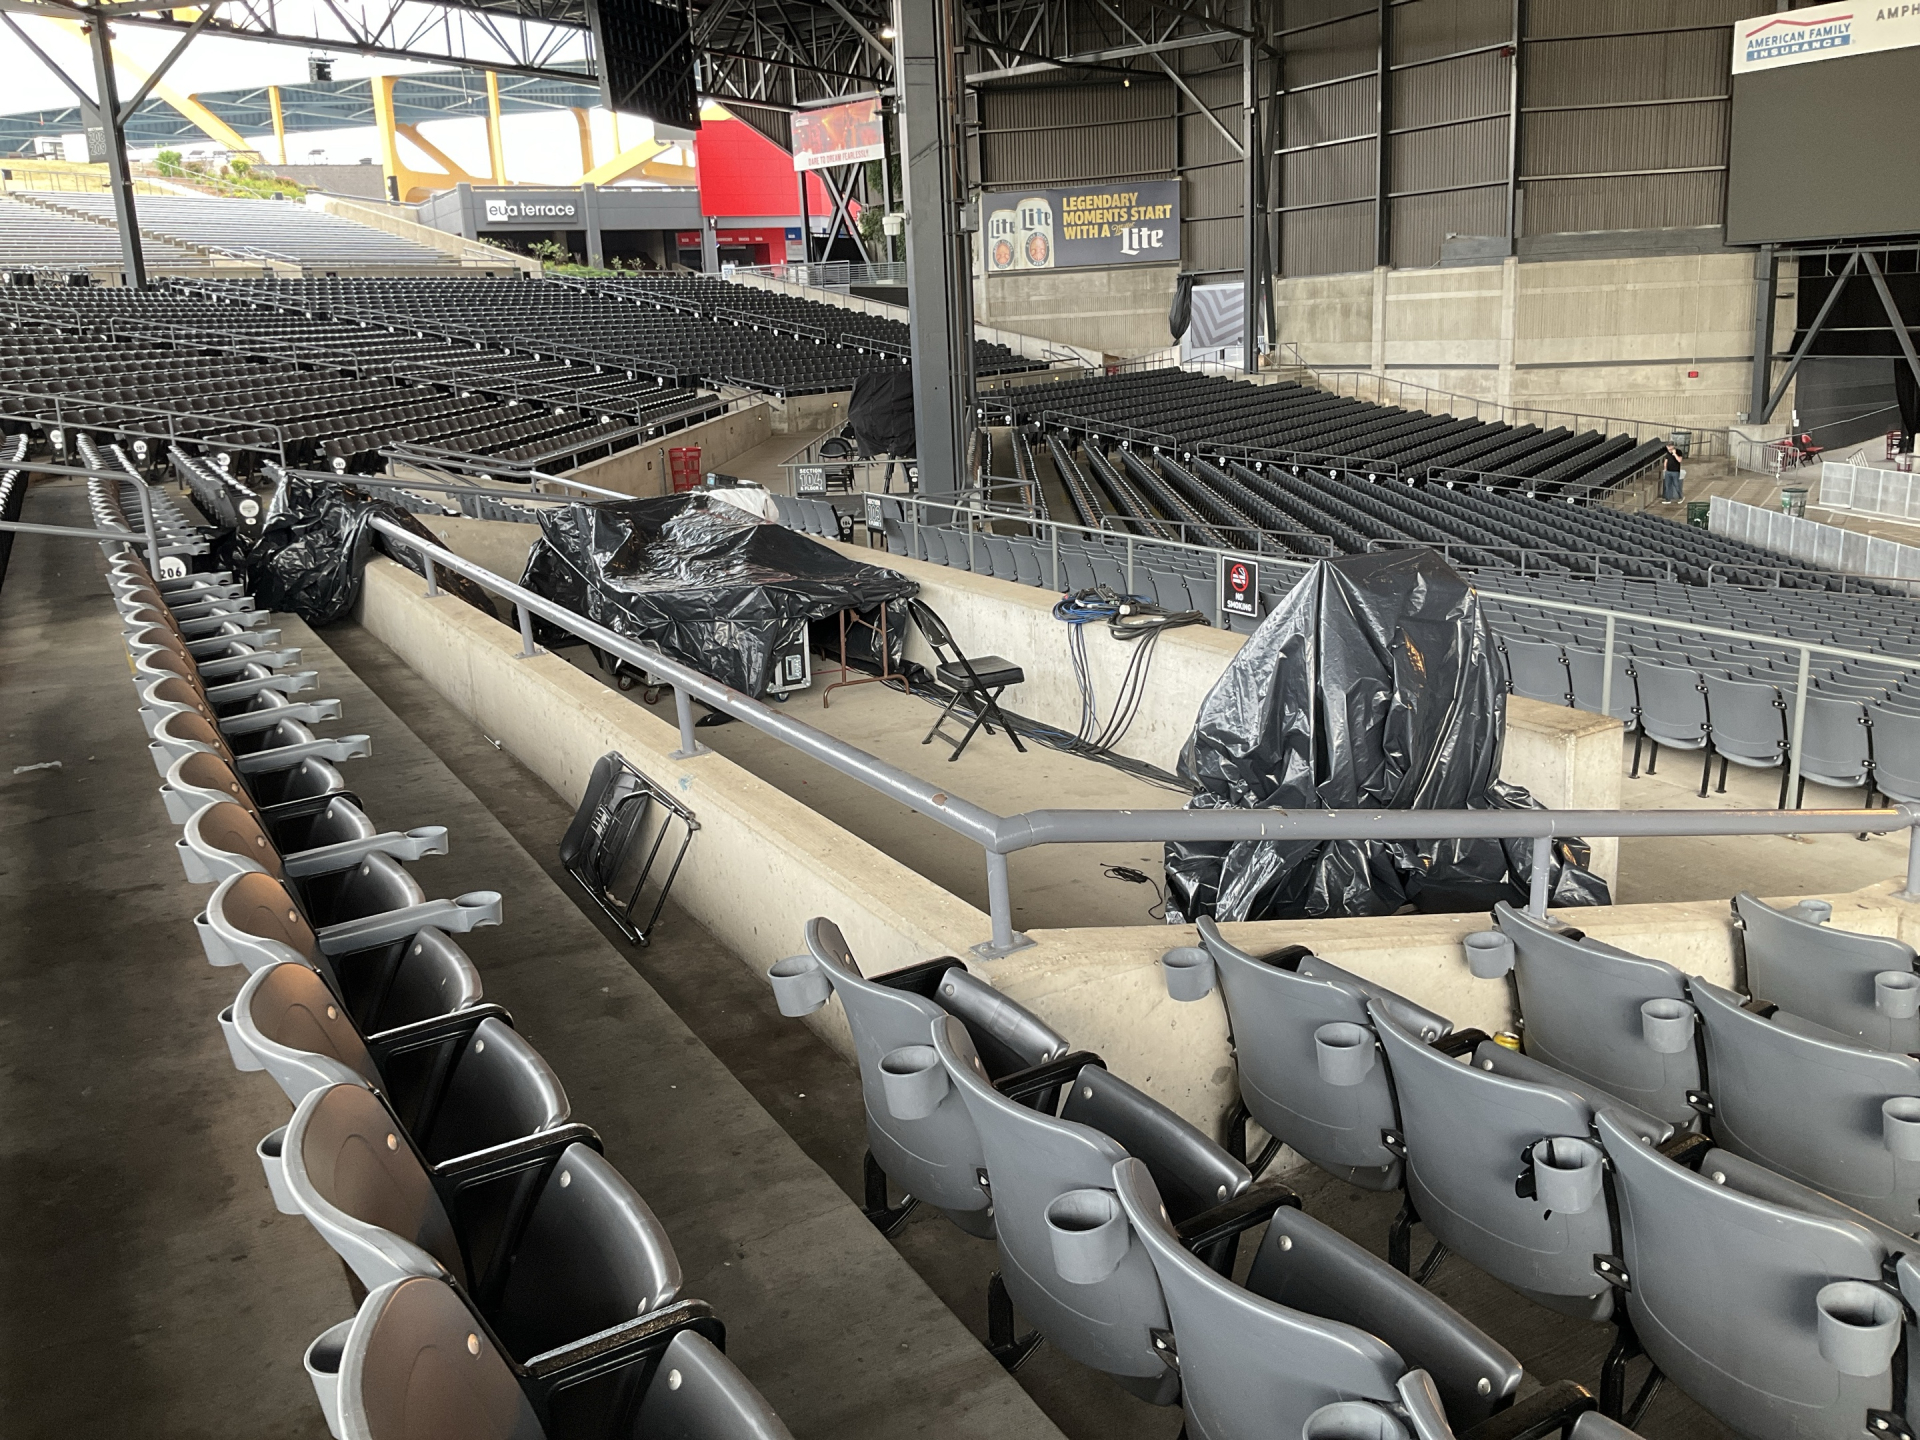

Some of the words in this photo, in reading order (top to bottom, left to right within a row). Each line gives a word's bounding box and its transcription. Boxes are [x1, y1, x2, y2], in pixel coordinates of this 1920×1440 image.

[1876, 3, 1920, 21] AMPH
[1747, 30, 1805, 50] AMERICAN
[1809, 22, 1851, 39] FAMILY
[1753, 37, 1842, 59] INSURANCE
[90, 142, 106, 155] 209
[808, 157, 819, 166] DARE
[820, 155, 826, 164] TO
[826, 150, 841, 163] DREAM
[489, 205, 518, 216] eua
[520, 202, 575, 216] terrace
[1063, 192, 1138, 211] LEGENDARY
[1021, 208, 1051, 232] Lite
[1063, 207, 1128, 225] MOMENTS
[1130, 204, 1172, 221] START
[990, 218, 1016, 239] Lite
[1063, 224, 1099, 240] WITH
[1100, 223, 1111, 238] A
[1120, 227, 1164, 256] Lite
[800, 473, 823, 487] 104
[160, 566, 182, 579] 206
[1235, 592, 1244, 601] NO
[1227, 599, 1252, 612] SMOKING
